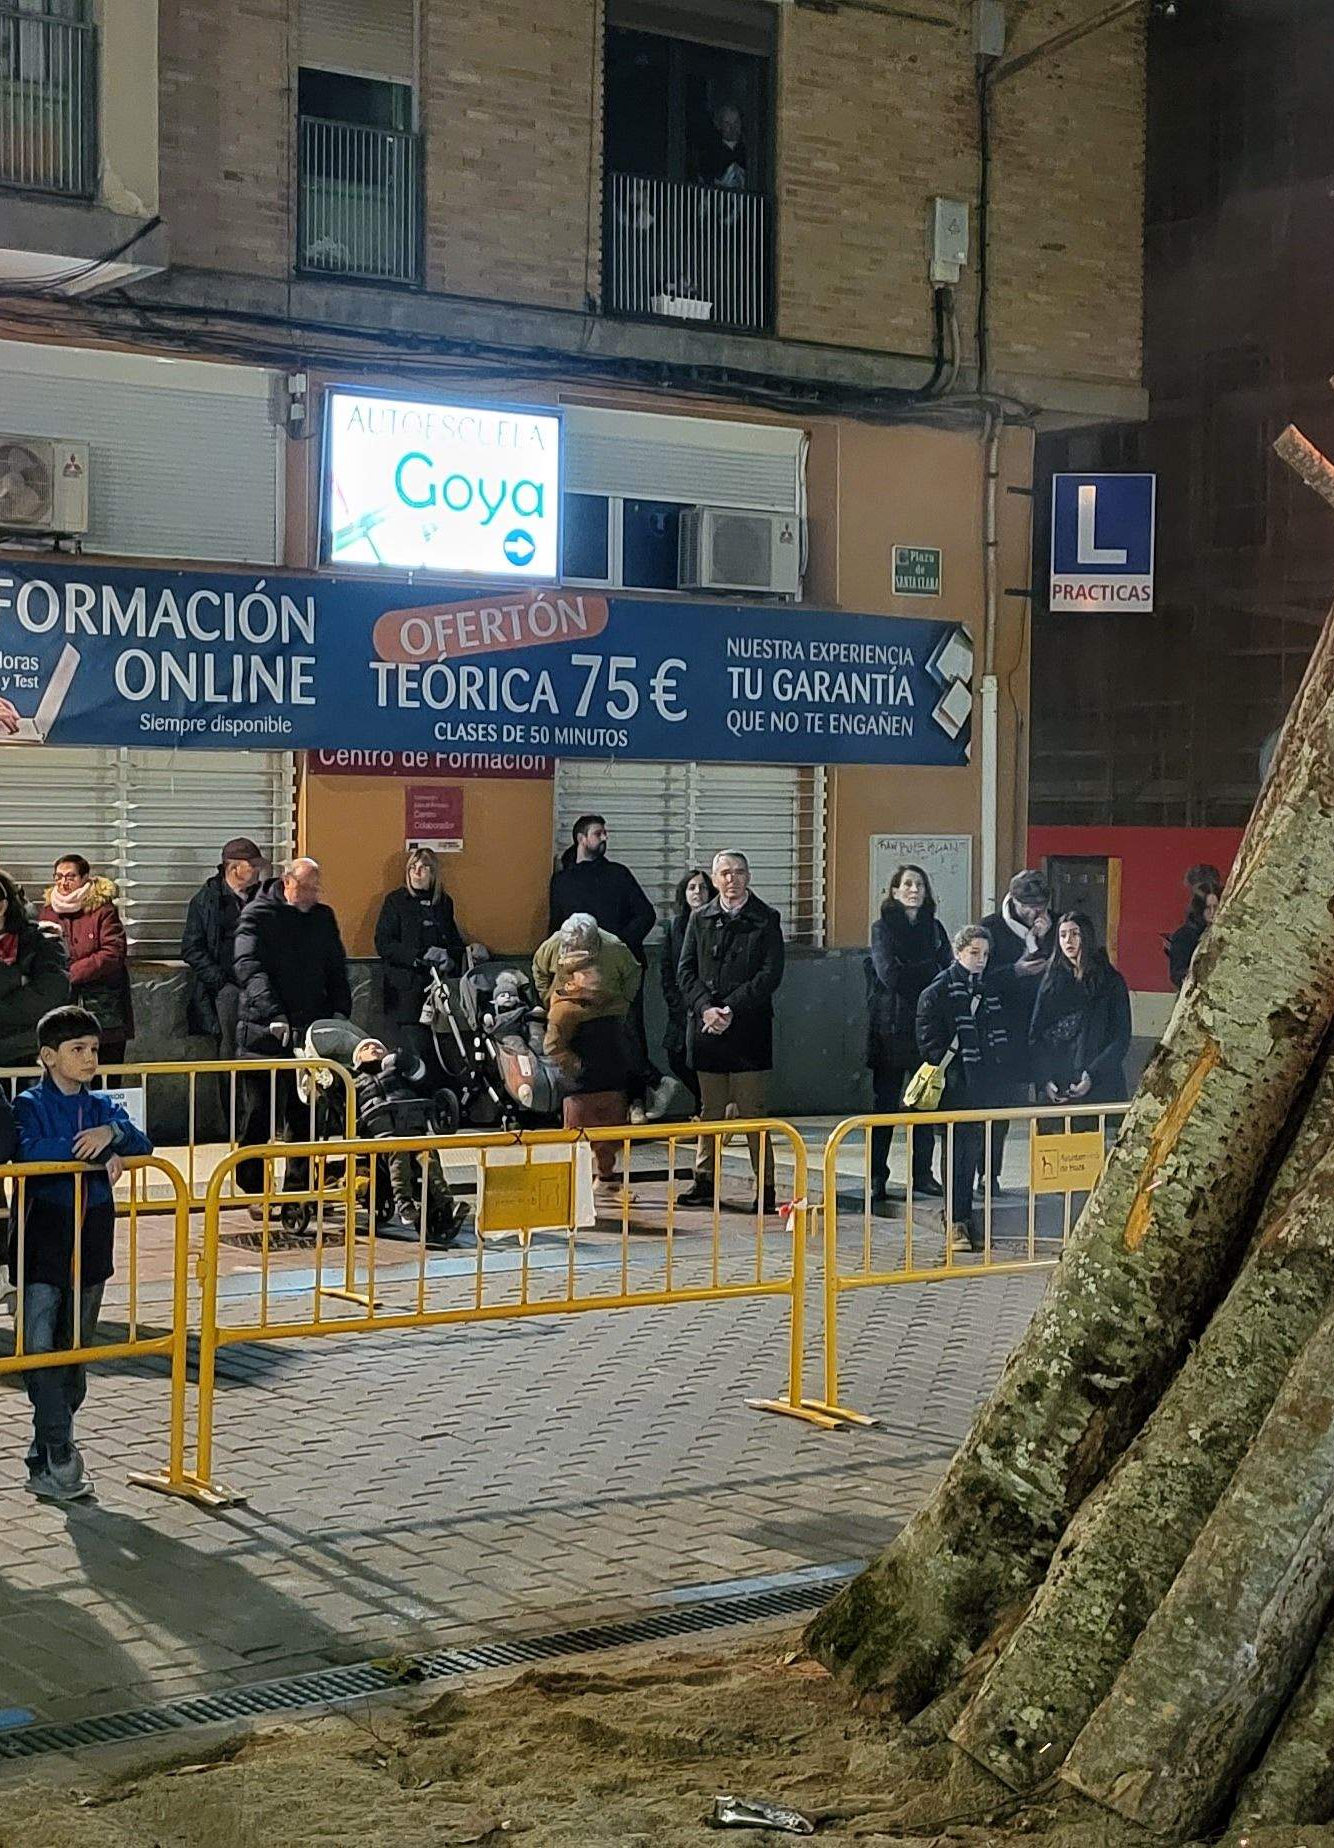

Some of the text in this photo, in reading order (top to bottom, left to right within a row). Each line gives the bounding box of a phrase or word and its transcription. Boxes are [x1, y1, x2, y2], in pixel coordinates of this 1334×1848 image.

[346, 405, 545, 450] AUTOESCUELA
[395, 451, 544, 526] Goya
[1077, 485, 1127, 564] L
[1052, 584, 1151, 601] PRACTICAS
[400, 592, 589, 656] OFERTÓN
[726, 637, 915, 667] NUESTRA EXPERIENCIA
[1, 676, 11, 691] y
[13, 673, 40, 689] Test
[115, 648, 317, 705] ONLINE
[369, 651, 560, 715] TEÓRICA
[727, 665, 915, 707] TU GARANTÍA
[140, 713, 293, 737] Siempre disponible
[434, 721, 629, 748] CLASES DE 50 MINUTOS
[726, 708, 914, 737] QUE NO TE ENGAÑEN
[319, 748, 395, 767] Centro
[401, 751, 429, 768] de
